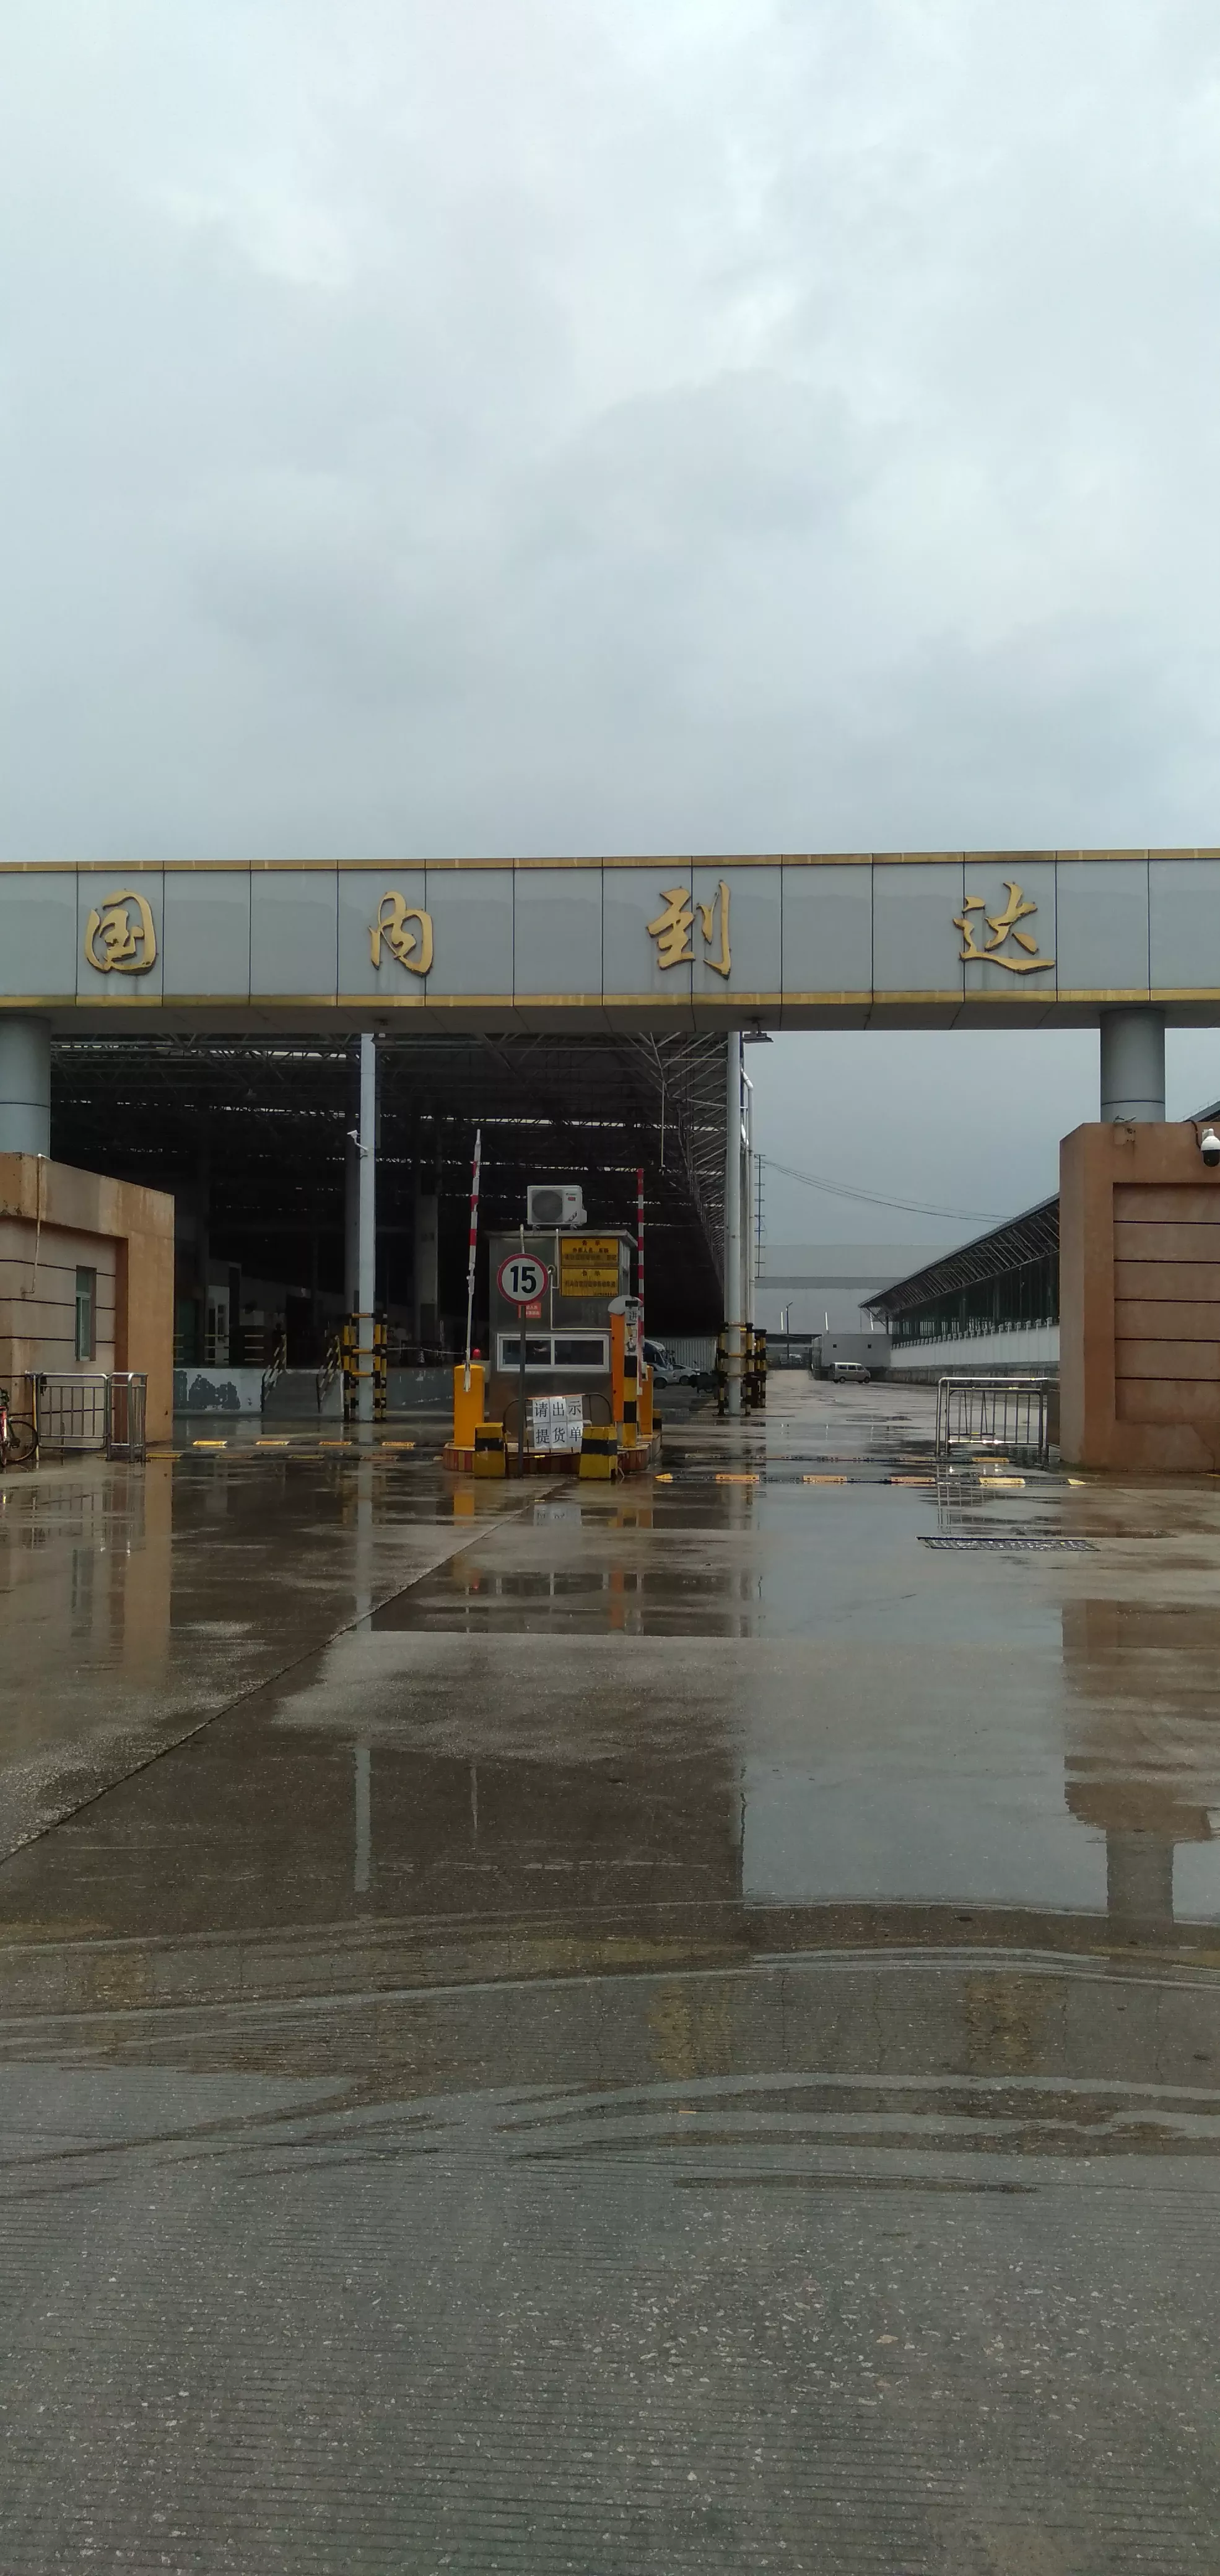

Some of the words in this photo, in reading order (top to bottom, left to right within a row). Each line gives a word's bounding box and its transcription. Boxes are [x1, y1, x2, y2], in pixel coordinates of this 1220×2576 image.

[85, 880, 1056, 980] 国内到达
[510, 1266, 536, 1294] 15
[534, 1401, 581, 1417] 请出示
[536, 1427, 582, 1444] 提货单
